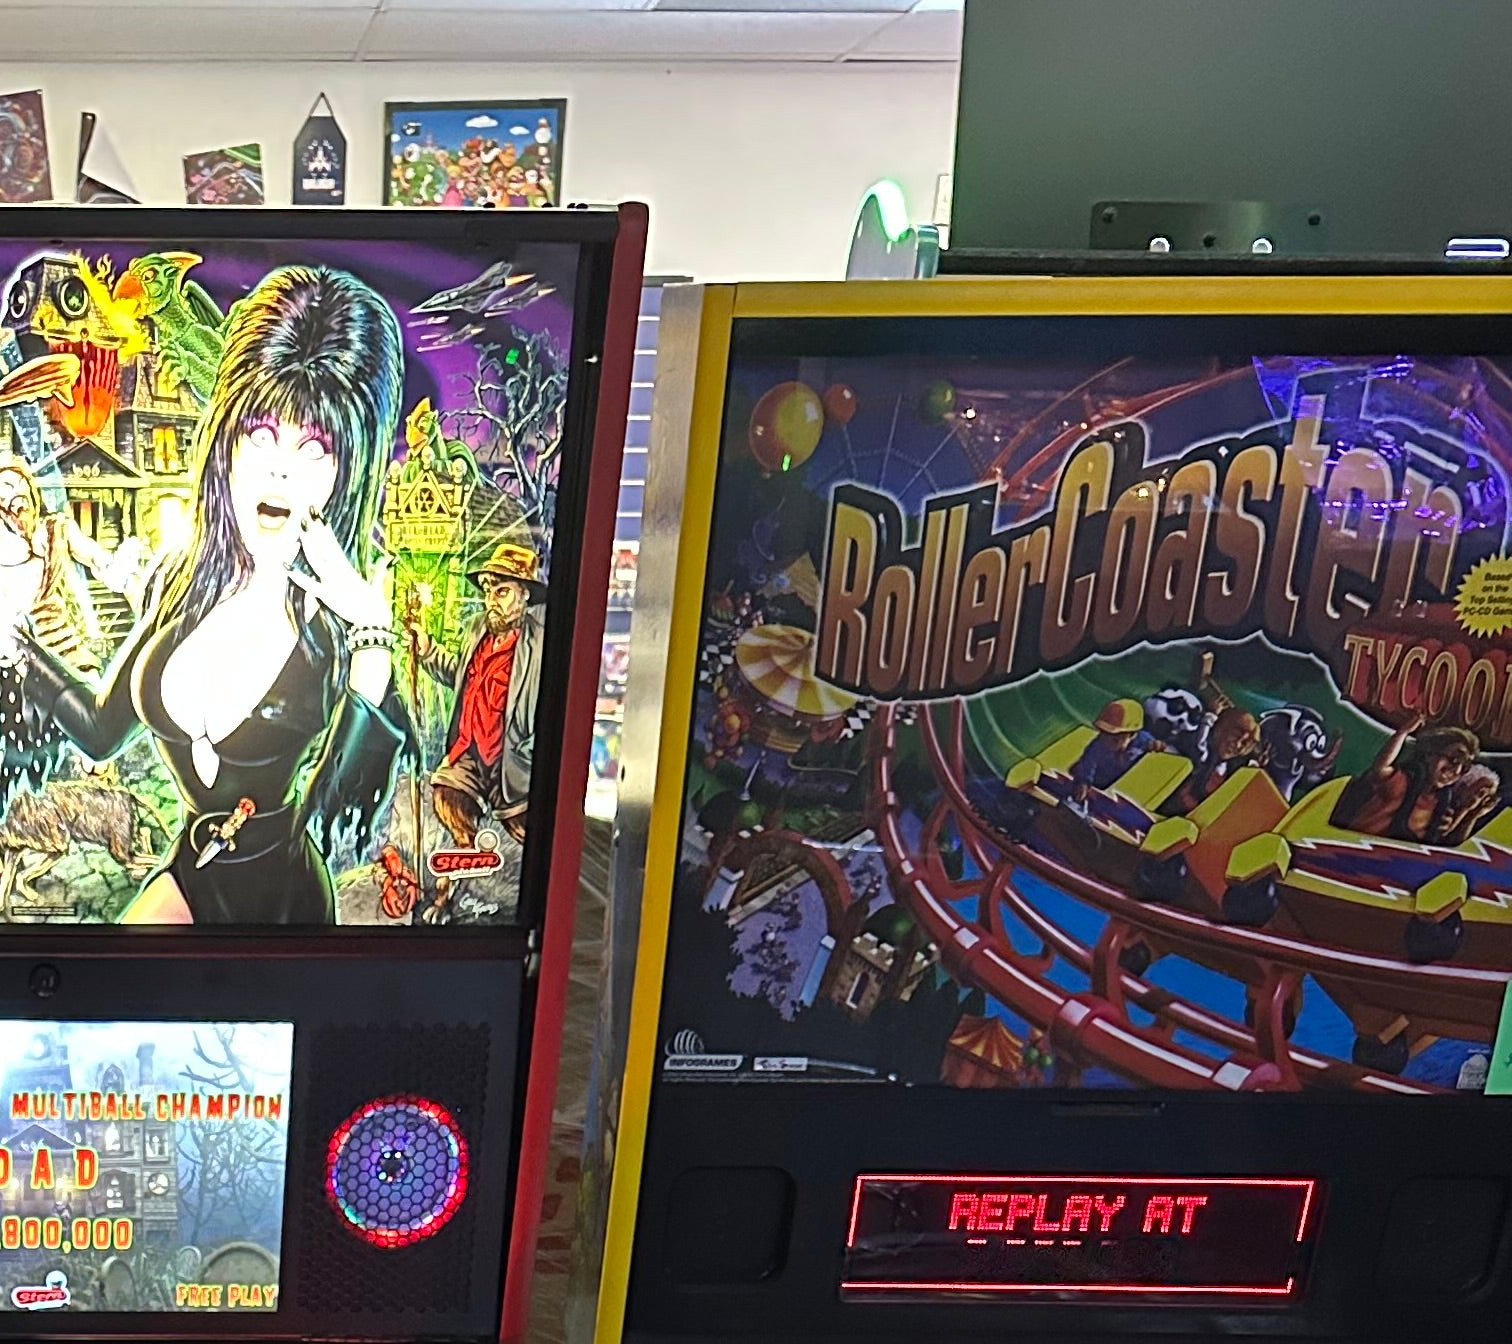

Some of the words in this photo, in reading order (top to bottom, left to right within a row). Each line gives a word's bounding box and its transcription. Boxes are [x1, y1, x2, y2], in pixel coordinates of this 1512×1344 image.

[817, 394, 1466, 695] RollerCoaster
[436, 855, 495, 871] Stern
[11, 1090, 147, 1120] MULTIBALL
[155, 1090, 283, 1122] CHAMPION
[949, 1192, 1126, 1233] REPLAY
[1141, 1195, 1208, 1236] AT
[16, 1287, 67, 1303] Stern
[175, 1285, 225, 1307] FREE
[228, 1285, 277, 1308] PLAY
